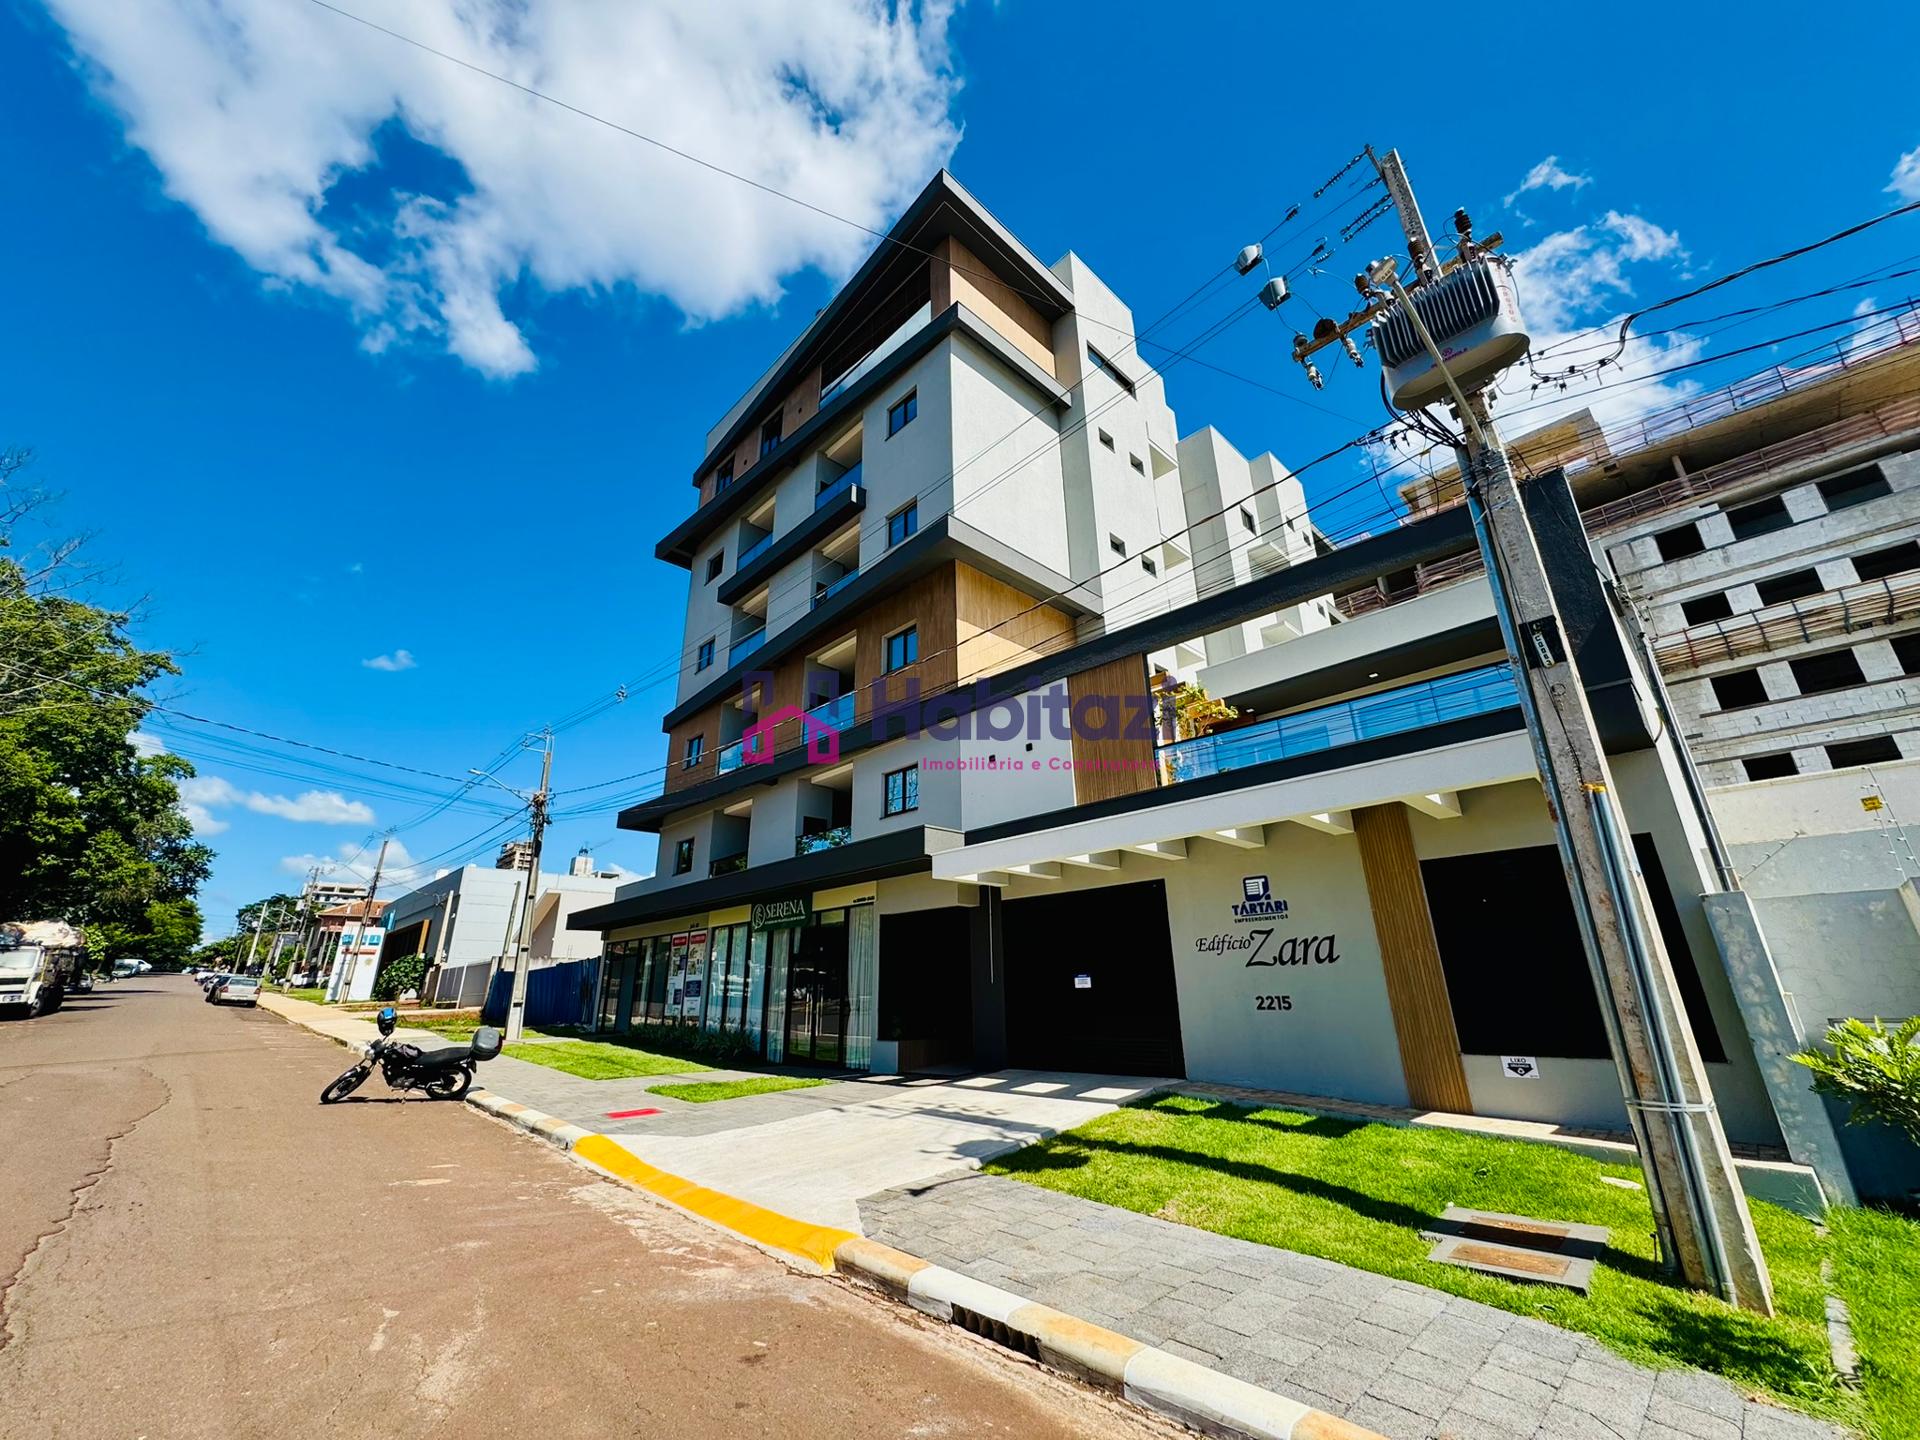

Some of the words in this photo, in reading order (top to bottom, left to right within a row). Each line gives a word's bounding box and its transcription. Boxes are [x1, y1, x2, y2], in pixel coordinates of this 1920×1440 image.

[766, 899, 806, 919] SERENA
[1234, 914, 1289, 924] EMPREENDIMENTOS
[1195, 934, 1252, 956] Edifício
[1245, 928, 1340, 967] Zara
[1255, 995, 1292, 1011] 2215
